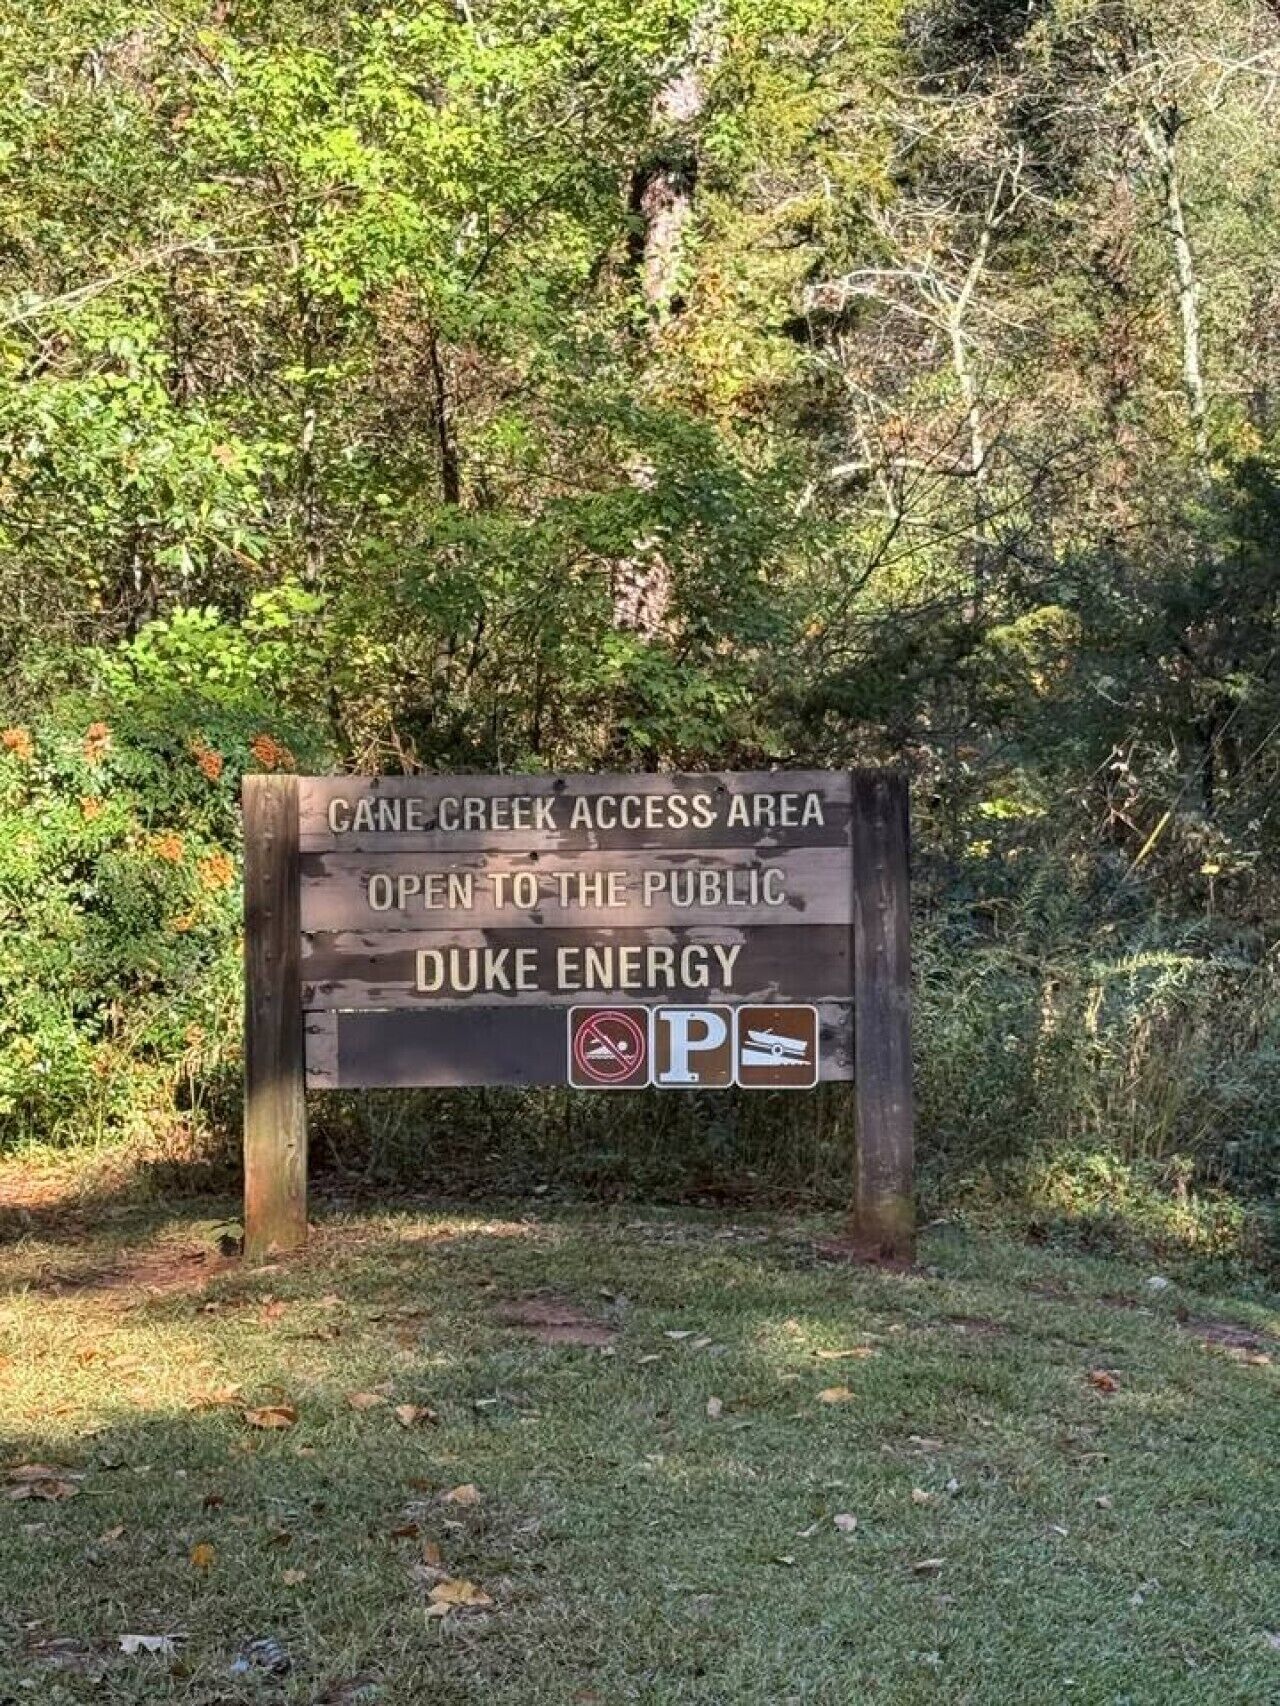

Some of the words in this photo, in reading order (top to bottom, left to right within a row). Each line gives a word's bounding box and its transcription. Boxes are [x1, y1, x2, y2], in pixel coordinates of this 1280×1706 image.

[328, 797, 424, 833] CANE
[438, 797, 557, 831] CREEK
[570, 795, 713, 830] ACCESS
[727, 793, 825, 828] AREA
[368, 873, 473, 911] OPEN
[488, 872, 539, 909] TO
[553, 871, 627, 907] THE
[643, 868, 785, 907] PUBLIC
[416, 948, 539, 992] DUKE
[557, 944, 742, 989] ENERGY
[659, 1010, 728, 1082] P
